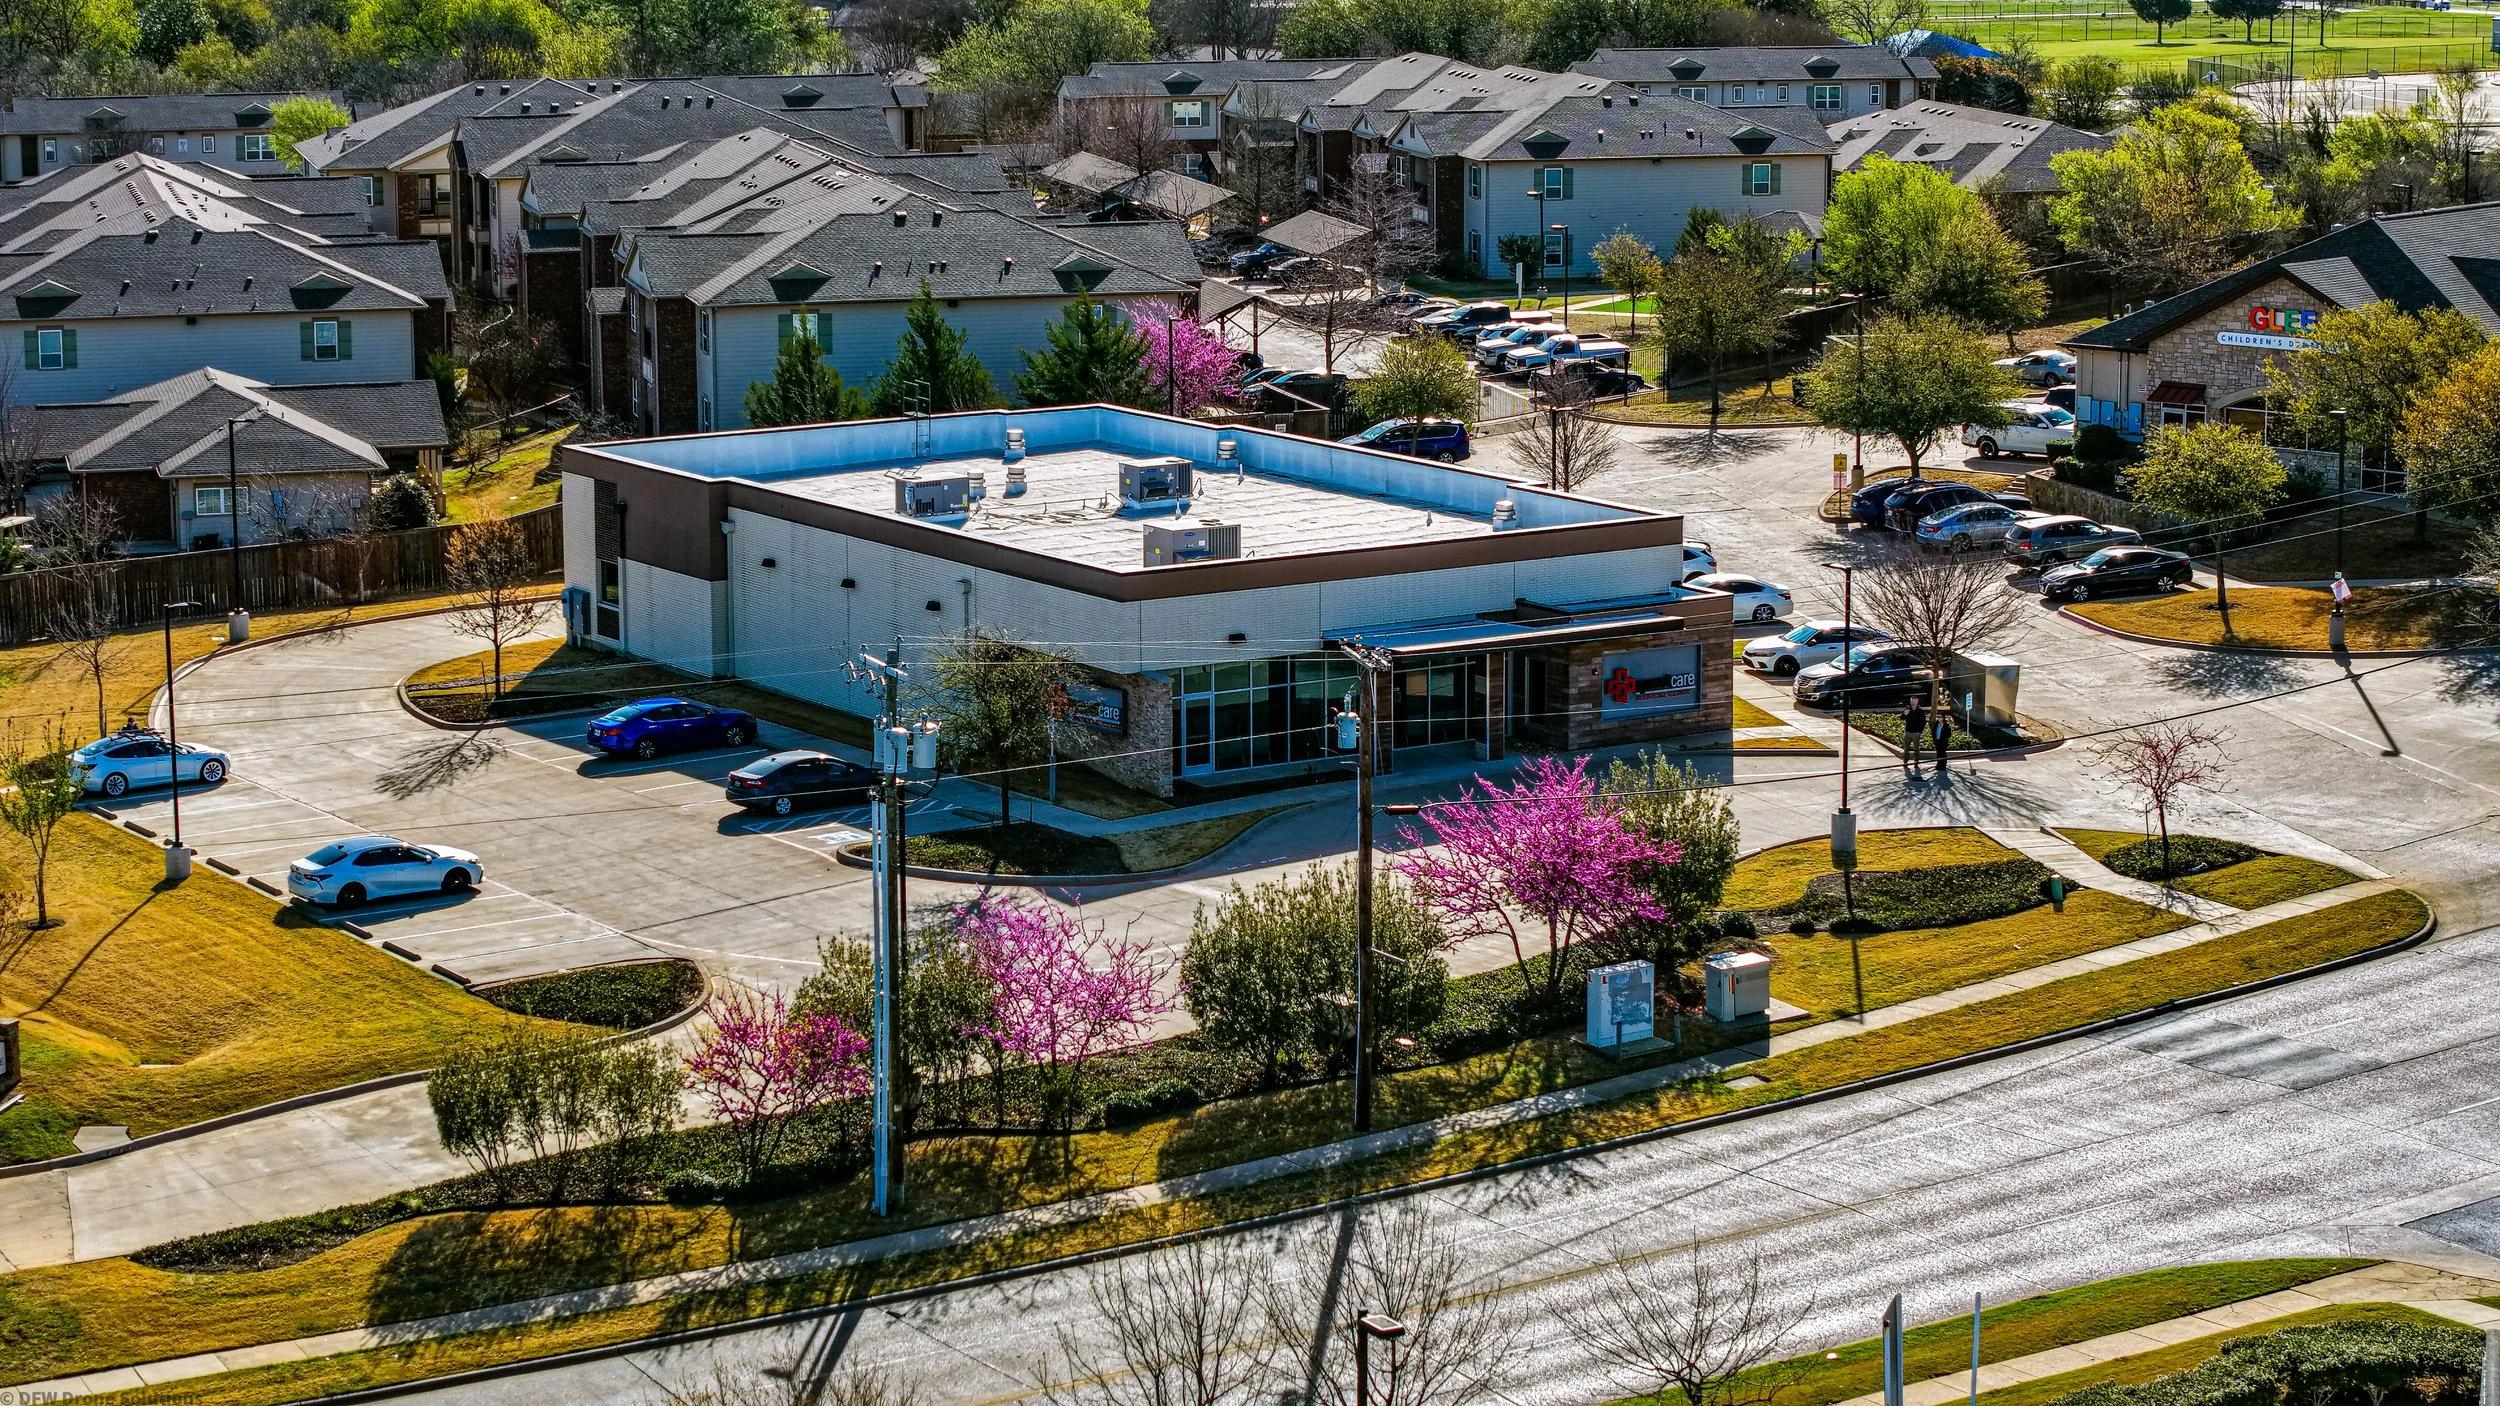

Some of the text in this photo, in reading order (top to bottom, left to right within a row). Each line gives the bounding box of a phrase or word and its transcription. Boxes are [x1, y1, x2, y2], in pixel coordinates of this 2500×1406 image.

[2249, 307, 2317, 333] GLEE
[2220, 334, 2283, 347] CHILDREN'S
[1671, 673, 1695, 687] care
[1098, 706, 1119, 720] care
